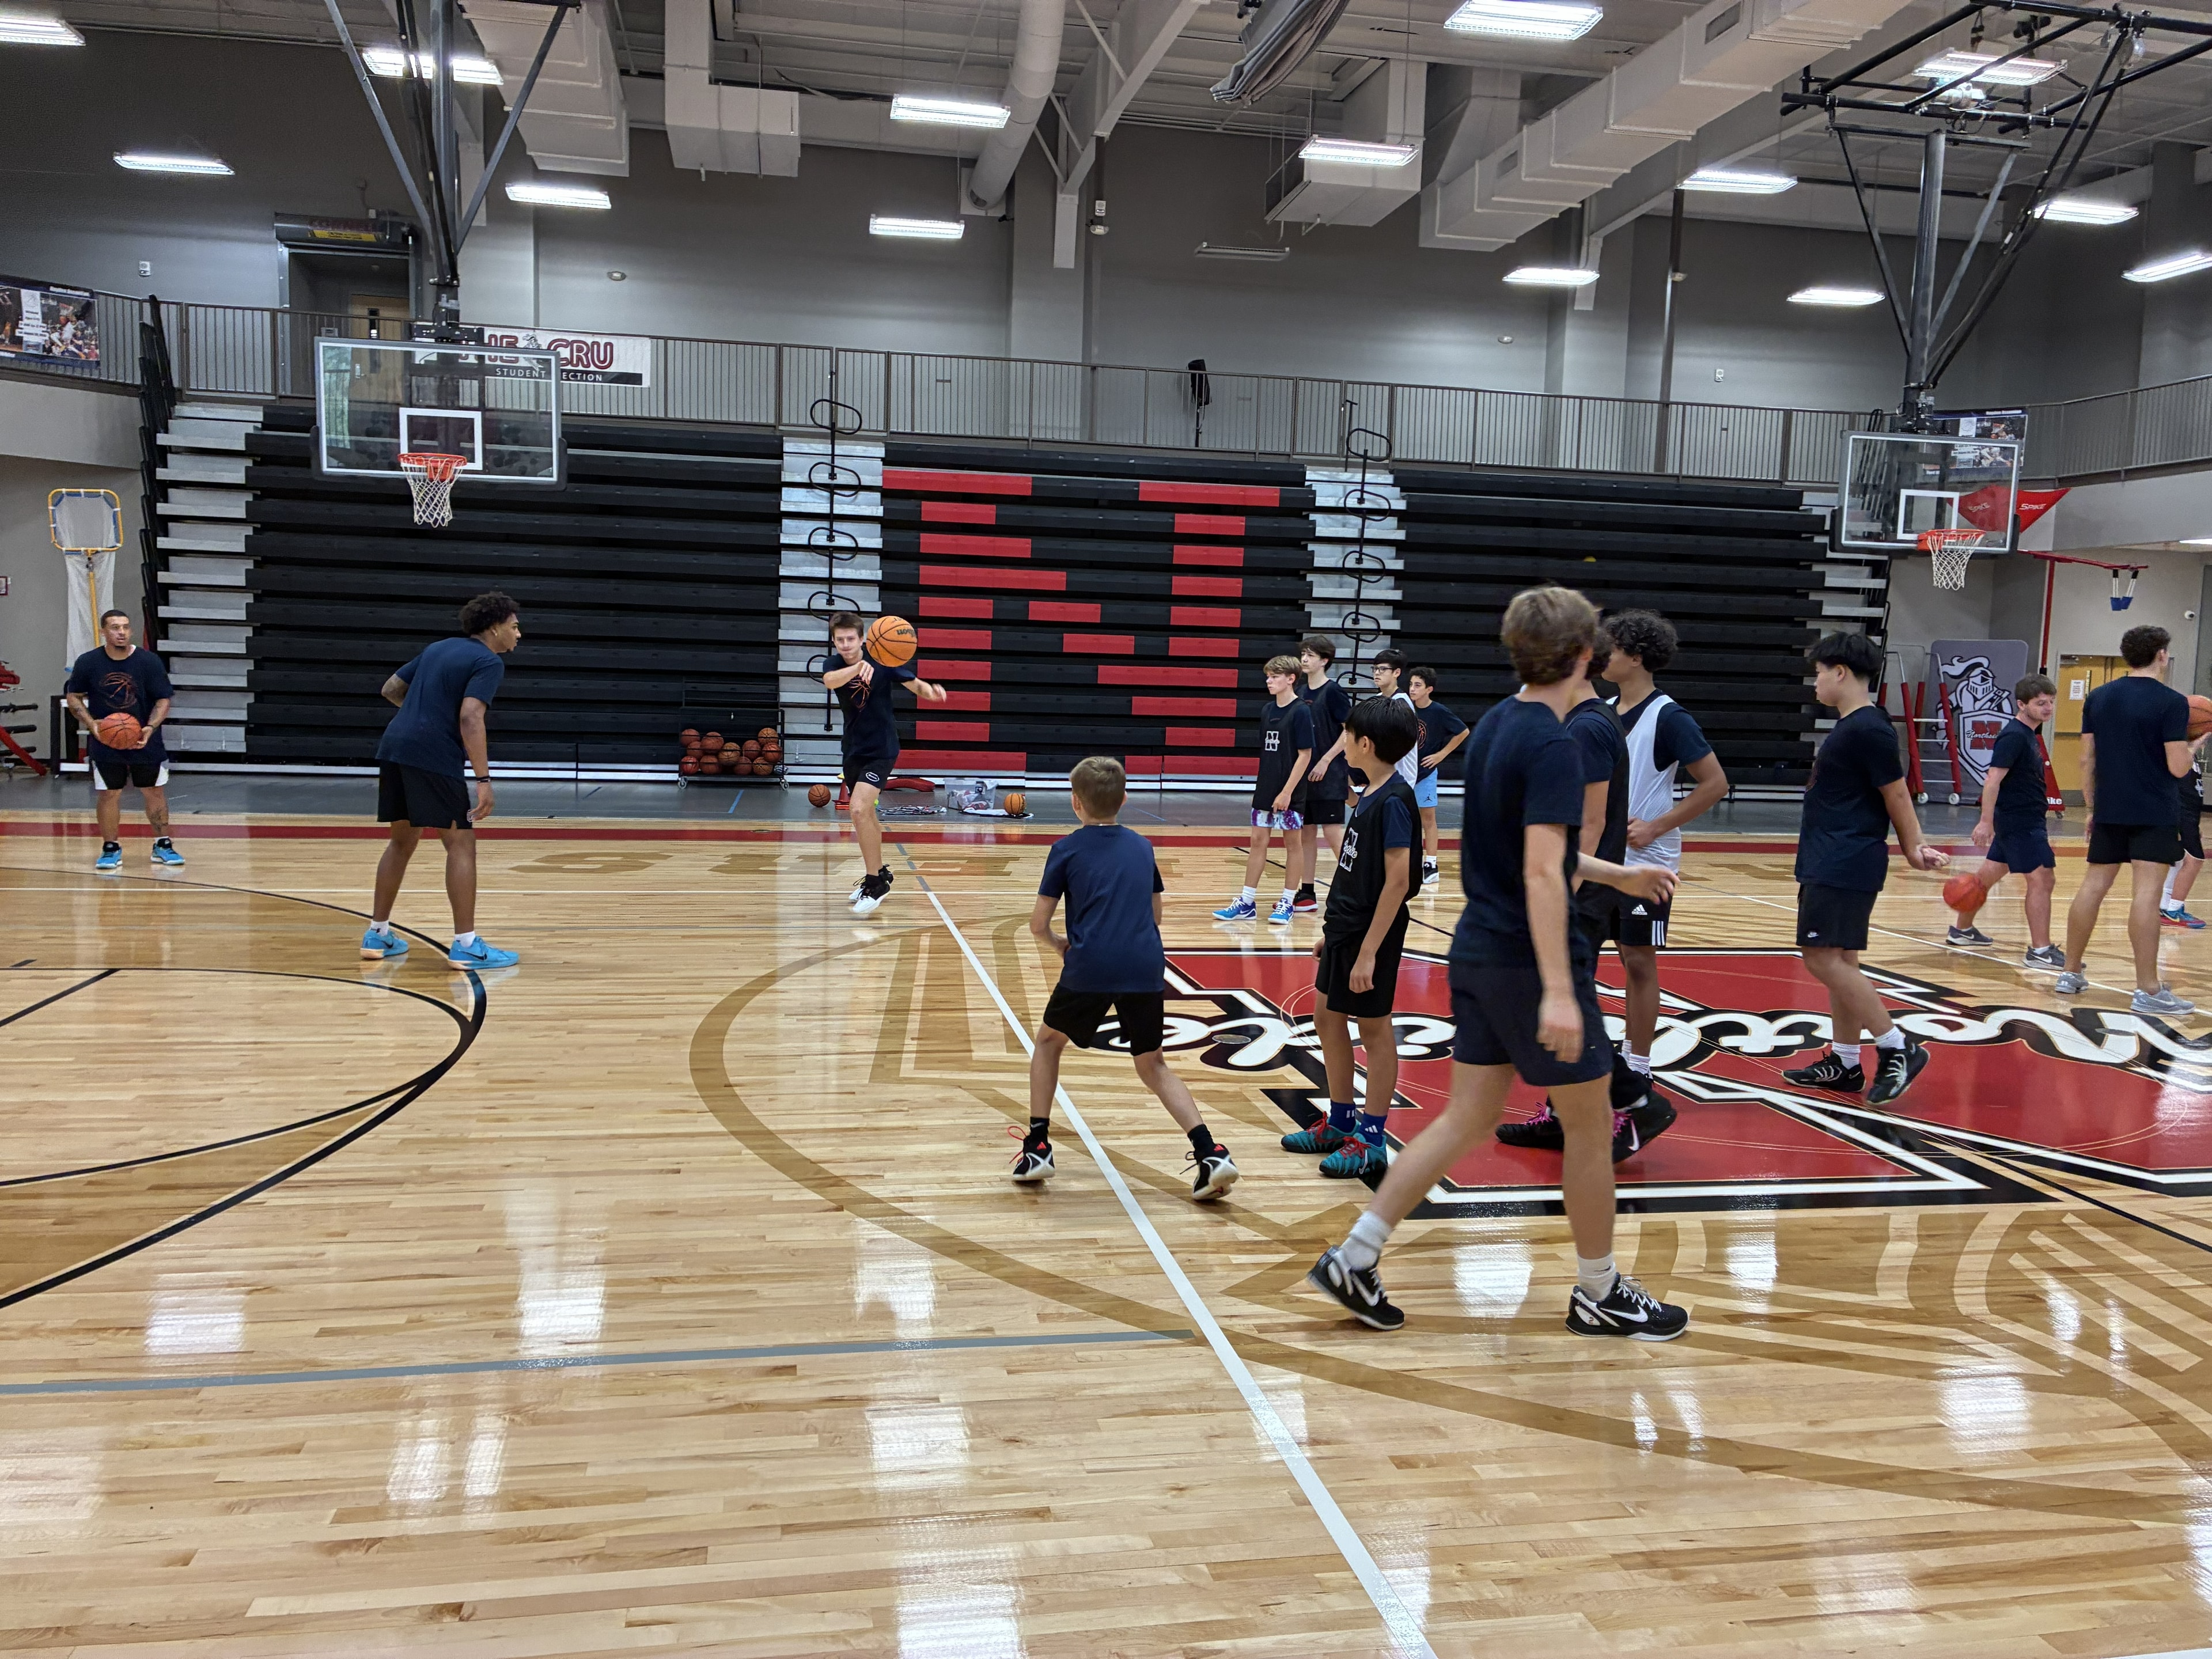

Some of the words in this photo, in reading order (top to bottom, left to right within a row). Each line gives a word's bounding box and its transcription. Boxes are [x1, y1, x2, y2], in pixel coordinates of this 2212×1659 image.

[547, 338, 613, 370] CRU
[495, 368, 547, 378] STUDENT
[562, 373, 602, 382] ECTION
[2019, 503, 2046, 511] SPIKE
